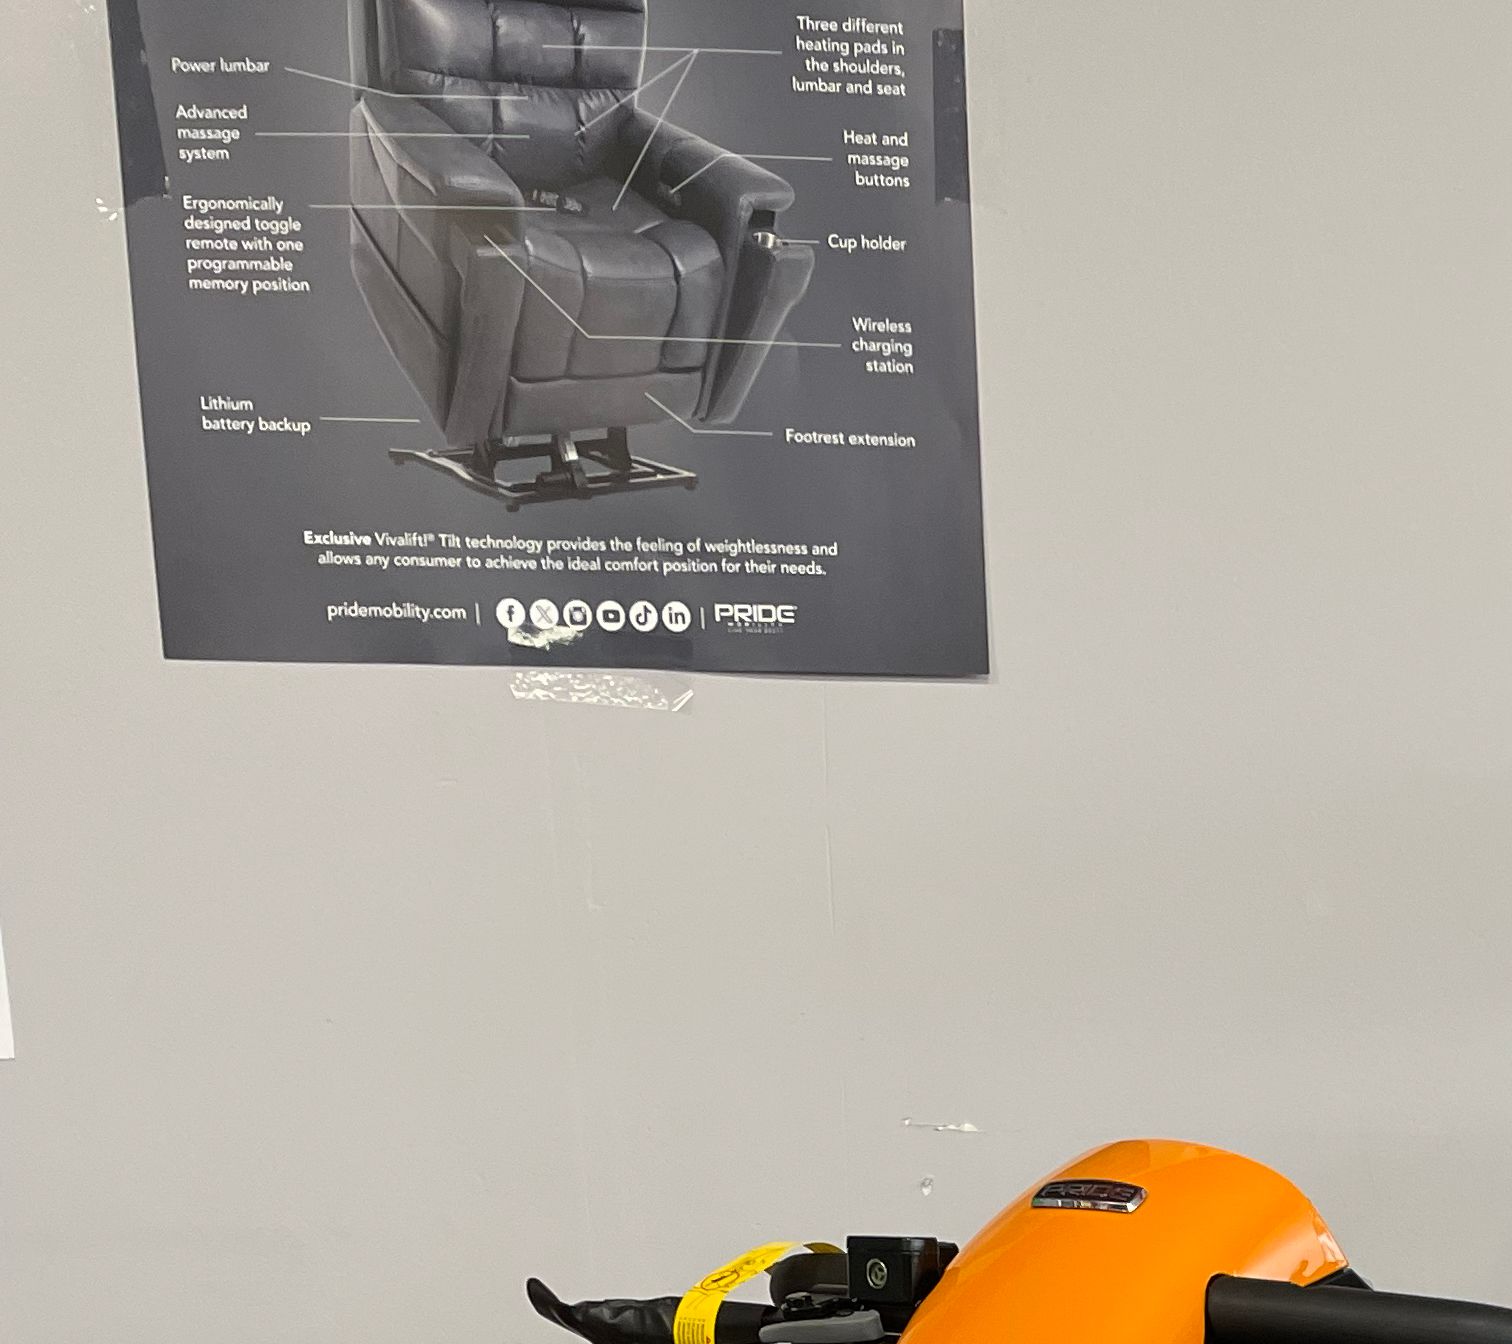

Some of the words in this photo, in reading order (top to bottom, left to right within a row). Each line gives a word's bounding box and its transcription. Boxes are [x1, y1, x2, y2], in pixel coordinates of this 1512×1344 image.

[797, 16, 837, 31] Three
[843, 17, 903, 35] different
[796, 36, 849, 56] heating
[854, 39, 888, 57] pads
[892, 41, 904, 55] in
[172, 58, 215, 72] Power
[220, 57, 269, 72] lumbar
[806, 57, 828, 71] the
[833, 58, 904, 77] shoulders,
[793, 76, 841, 92] lumbar
[846, 80, 872, 94] and
[877, 82, 905, 96] seat
[176, 105, 247, 119] Advanced
[178, 127, 240, 143] massage
[844, 130, 877, 145] Heat
[882, 132, 908, 146] and
[179, 148, 229, 162] system
[848, 152, 909, 169] massage
[856, 173, 910, 187] buttons
[183, 196, 283, 214] Ergonomically
[185, 217, 251, 233] designed
[255, 217, 301, 234] toggle
[186, 238, 238, 250] remote
[241, 237, 272, 250] with
[277, 241, 303, 251] one
[828, 234, 857, 253] Cup
[861, 235, 906, 250] holder
[188, 257, 293, 273] programmable
[189, 279, 248, 294] memory
[253, 277, 310, 295] position
[853, 317, 911, 333] Wireless
[852, 337, 912, 356] charging
[866, 359, 913, 373] station
[201, 396, 253, 410] Lithium
[202, 416, 254, 434] battery
[258, 417, 310, 434] backup
[786, 429, 844, 444] Footrest
[849, 431, 915, 448] extension
[304, 531, 371, 545] Exclusive
[439, 534, 461, 548] Tilt
[465, 535, 542, 554] technology
[546, 537, 606, 554] provides
[610, 537, 632, 551] the
[636, 537, 683, 556] feeling
[687, 538, 701, 552] of
[705, 539, 807, 557] weightlessness
[812, 542, 837, 555] and
[318, 551, 361, 565] allows
[366, 555, 389, 569] any
[394, 556, 461, 567] consumer
[466, 556, 481, 568] to
[485, 558, 537, 569] achieve
[541, 558, 564, 570] the
[568, 558, 601, 570] ideal
[605, 559, 659, 572] comfort
[663, 561, 717, 576] position
[722, 560, 741, 572] for
[745, 562, 776, 573] their
[781, 563, 826, 575] needs.
[328, 602, 466, 622] pridemobility.com
